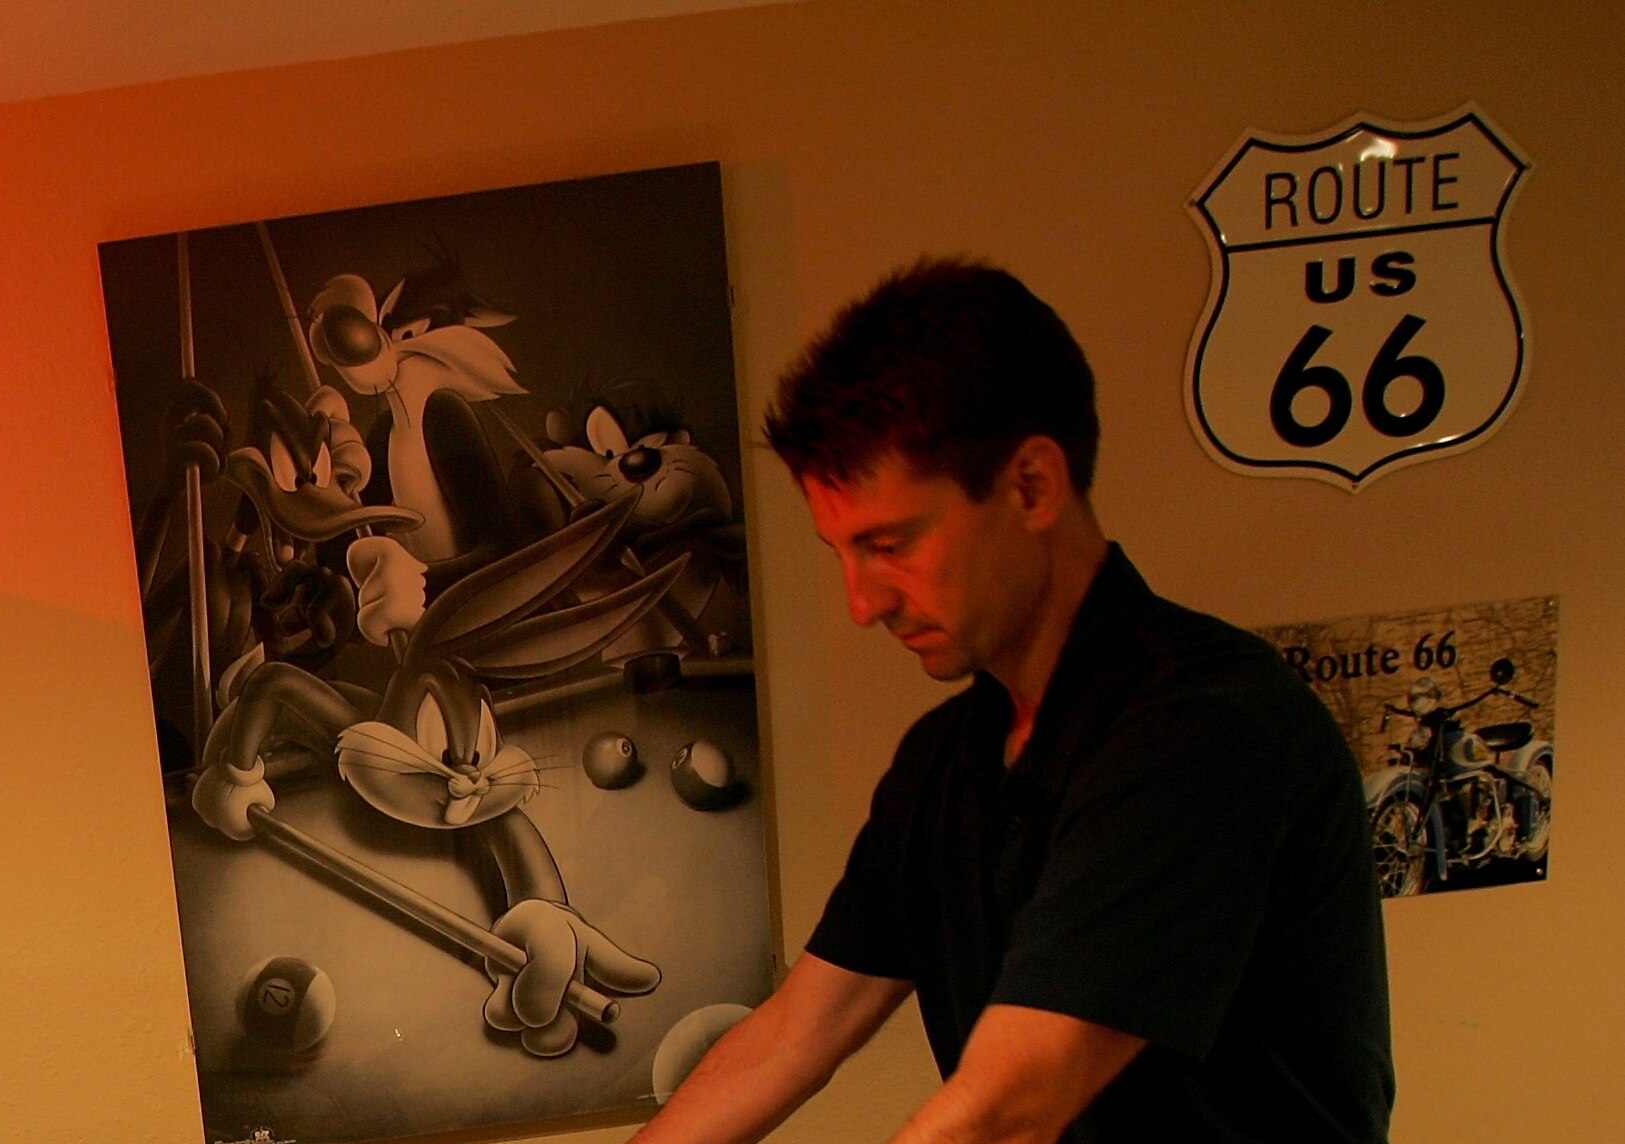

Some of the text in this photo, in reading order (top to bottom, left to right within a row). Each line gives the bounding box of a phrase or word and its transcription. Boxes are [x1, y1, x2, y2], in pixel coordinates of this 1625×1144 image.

[1264, 152, 1459, 229] ROUTE
[1304, 250, 1417, 303] US
[1269, 313, 1446, 448] 66
[1282, 630, 1458, 684] Route 66
[262, 983, 292, 1008] 12
